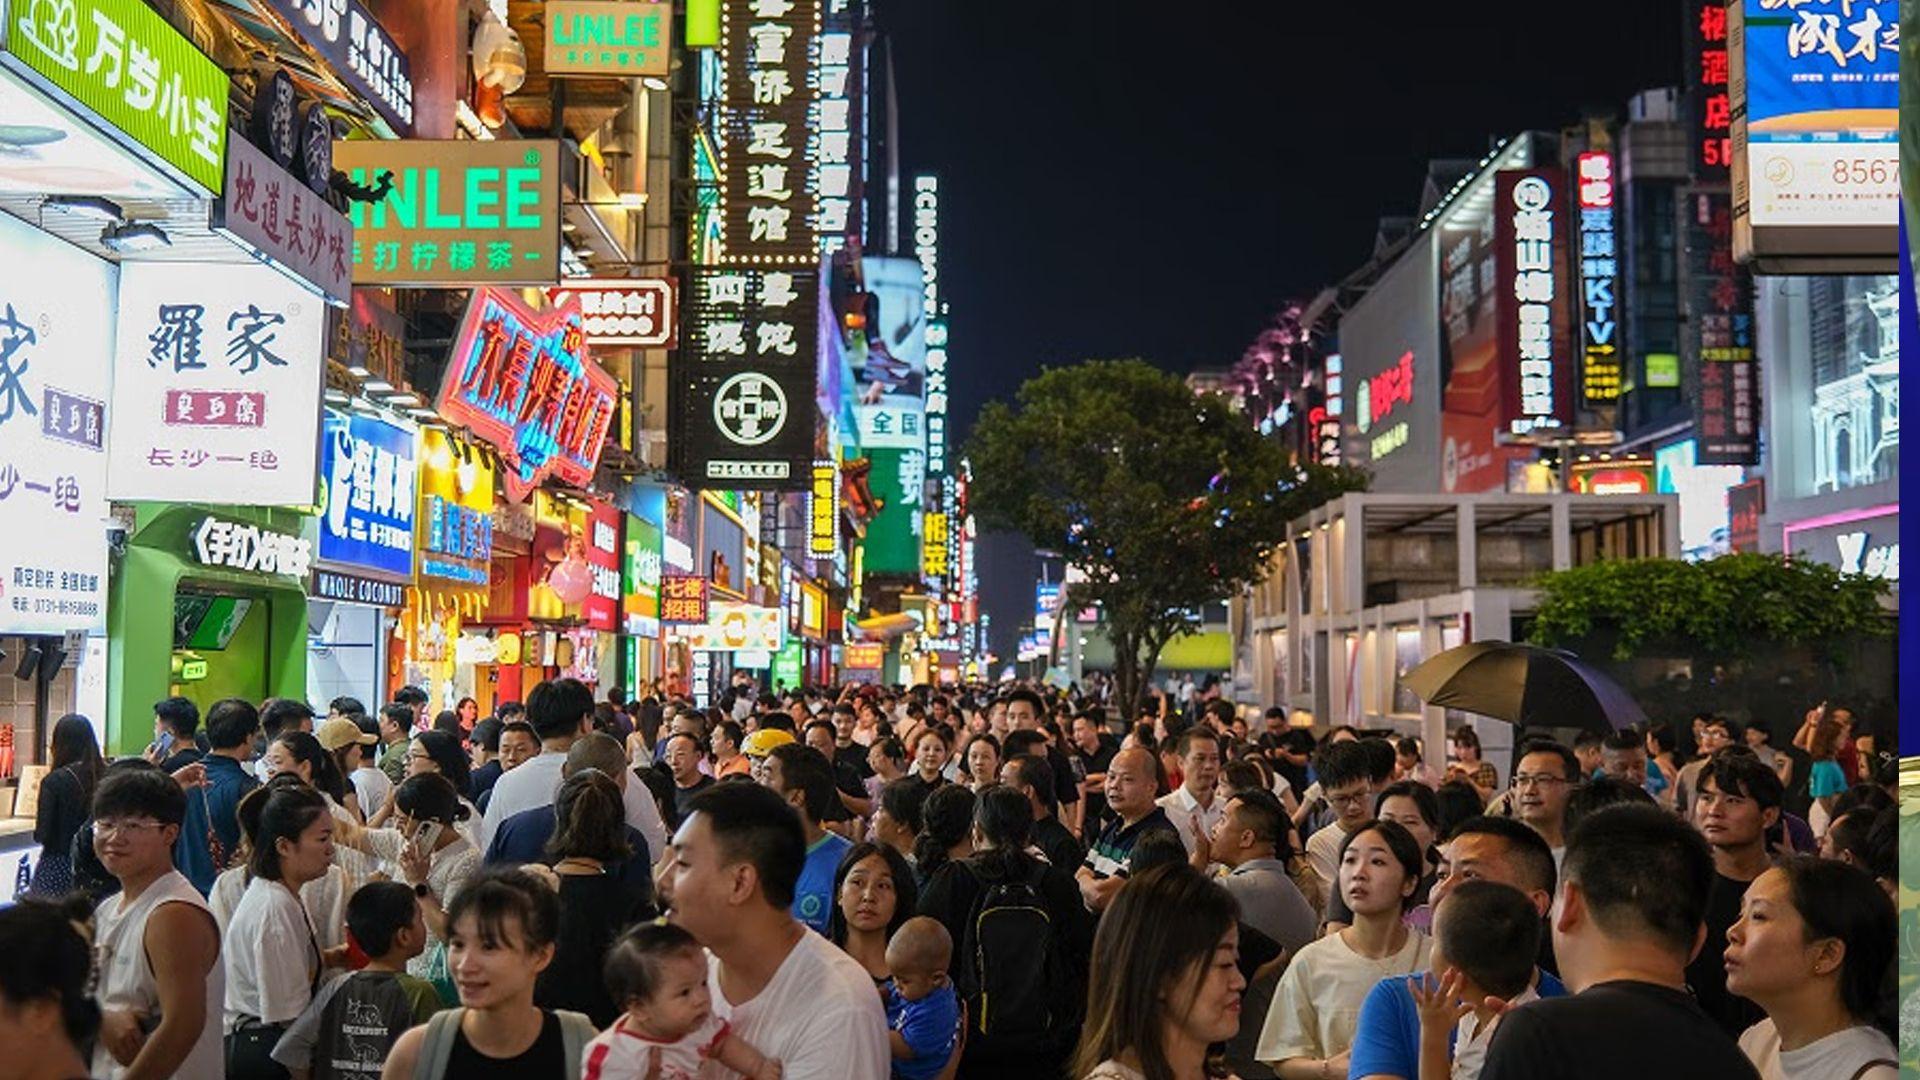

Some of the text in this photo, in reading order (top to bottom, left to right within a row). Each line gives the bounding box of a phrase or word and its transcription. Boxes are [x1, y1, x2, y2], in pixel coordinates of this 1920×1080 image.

[553, 15, 660, 47] LINLEE
[84, 8, 222, 167] 万岁小主
[350, 168, 541, 229] INLEE
[232, 160, 347, 284] 地道長沙味
[146, 303, 290, 375] 羅家
[871, 411, 919, 437] 全国
[146, 448, 280, 471] 长沙一绝
[318, 573, 356, 599] WHOLE
